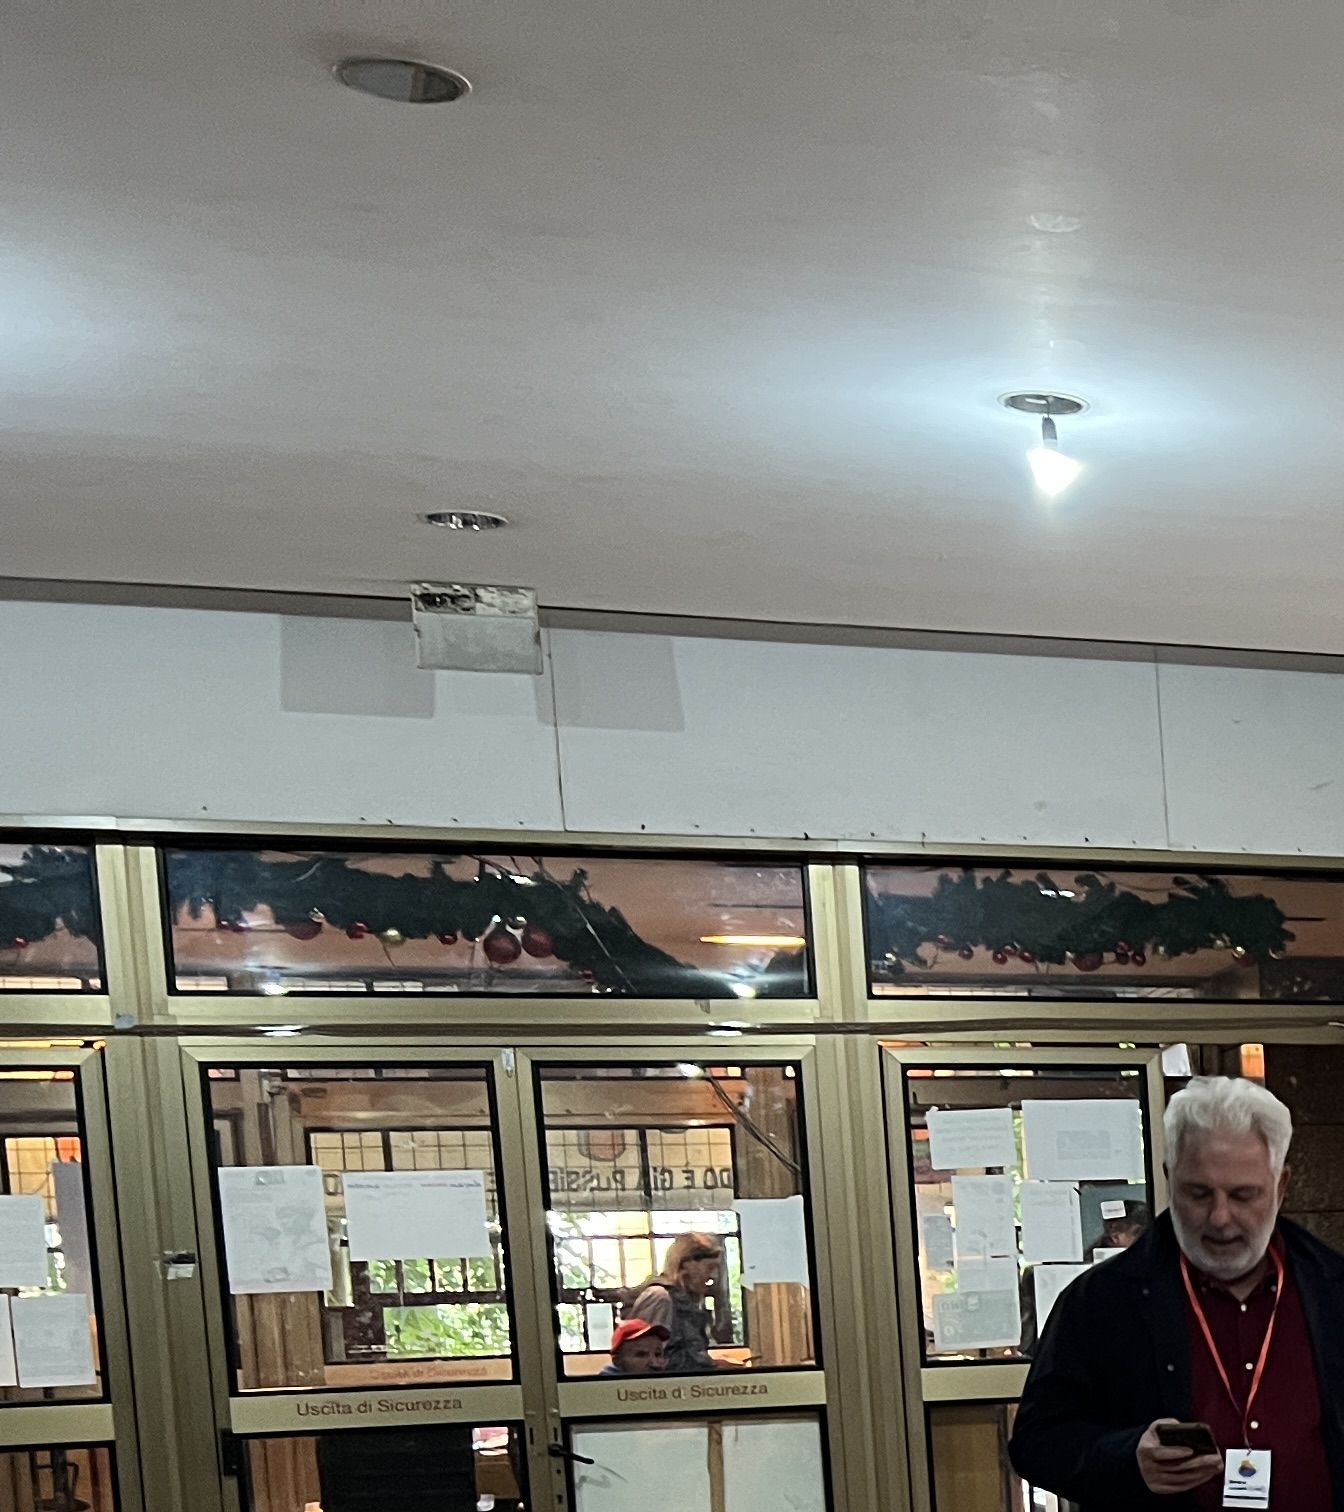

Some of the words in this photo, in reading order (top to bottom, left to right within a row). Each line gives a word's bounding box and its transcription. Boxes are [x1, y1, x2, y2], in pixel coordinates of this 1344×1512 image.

[616, 1385, 668, 1402] Uscita
[671, 1386, 686, 1400] d
[689, 1382, 769, 1399] Sicurezza
[295, 1400, 353, 1417] Uscita
[356, 1400, 373, 1414] di
[376, 1398, 463, 1413] Sicurezza
